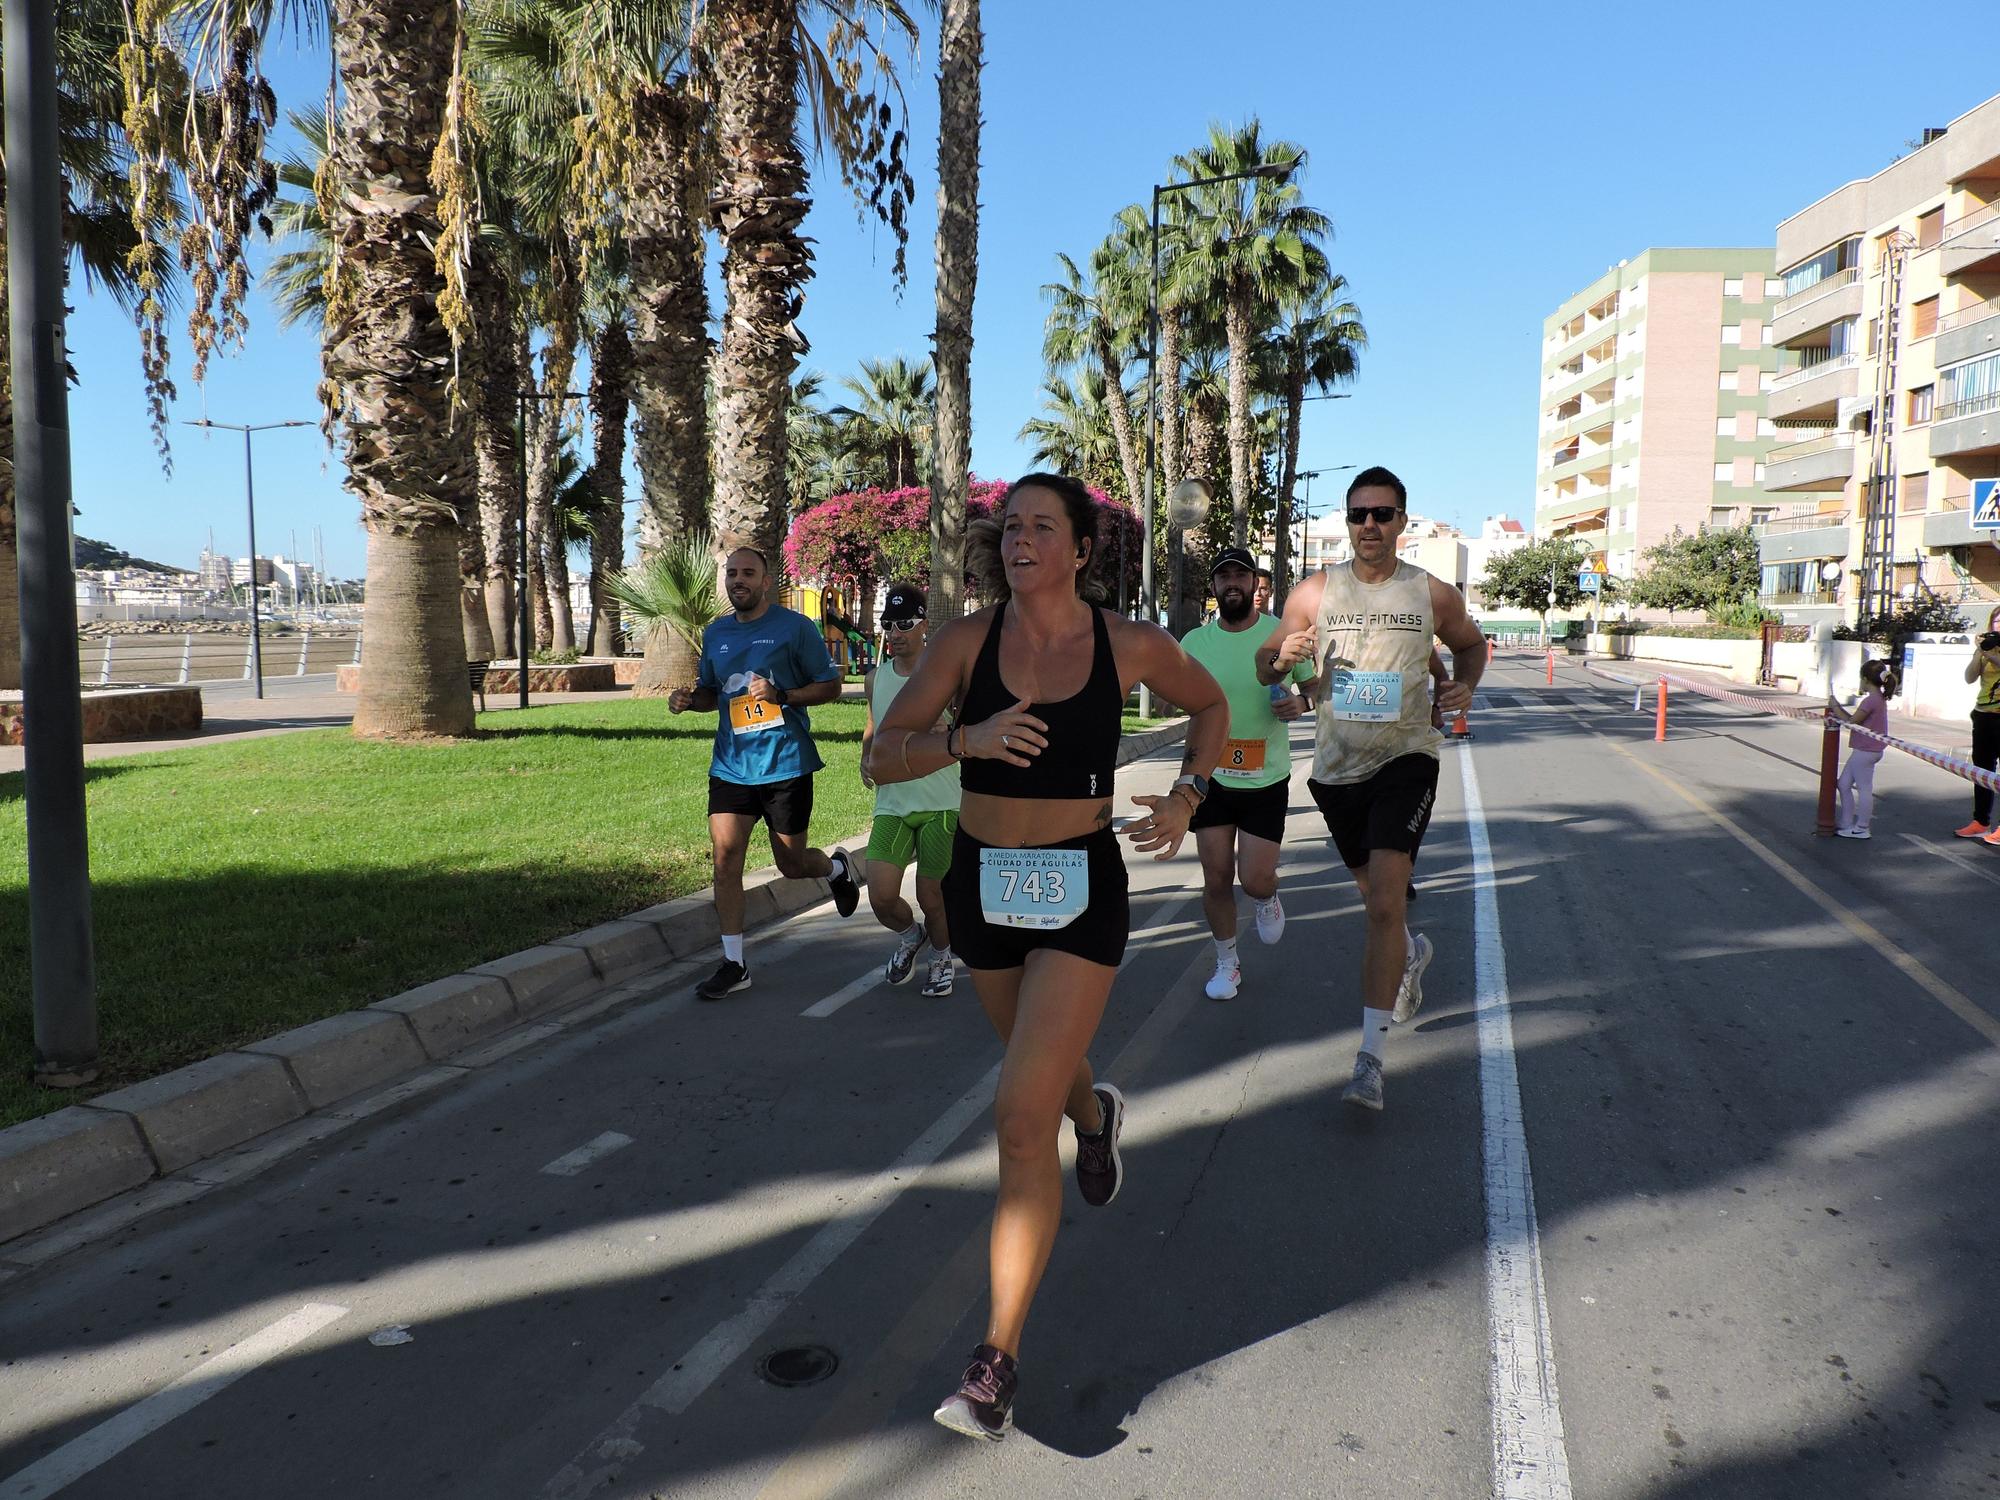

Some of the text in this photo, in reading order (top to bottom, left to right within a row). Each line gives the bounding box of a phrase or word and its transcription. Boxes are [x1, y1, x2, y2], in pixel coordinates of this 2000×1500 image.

[1326, 614, 1422, 626] WAVE FITNESS
[1345, 684, 1388, 705] 742
[744, 703, 764, 721] 14
[1232, 749, 1244, 765] 8
[1407, 788, 1432, 833] WAVE
[1041, 859, 1083, 868] ÁGUILAS
[999, 870, 1067, 904] 743
